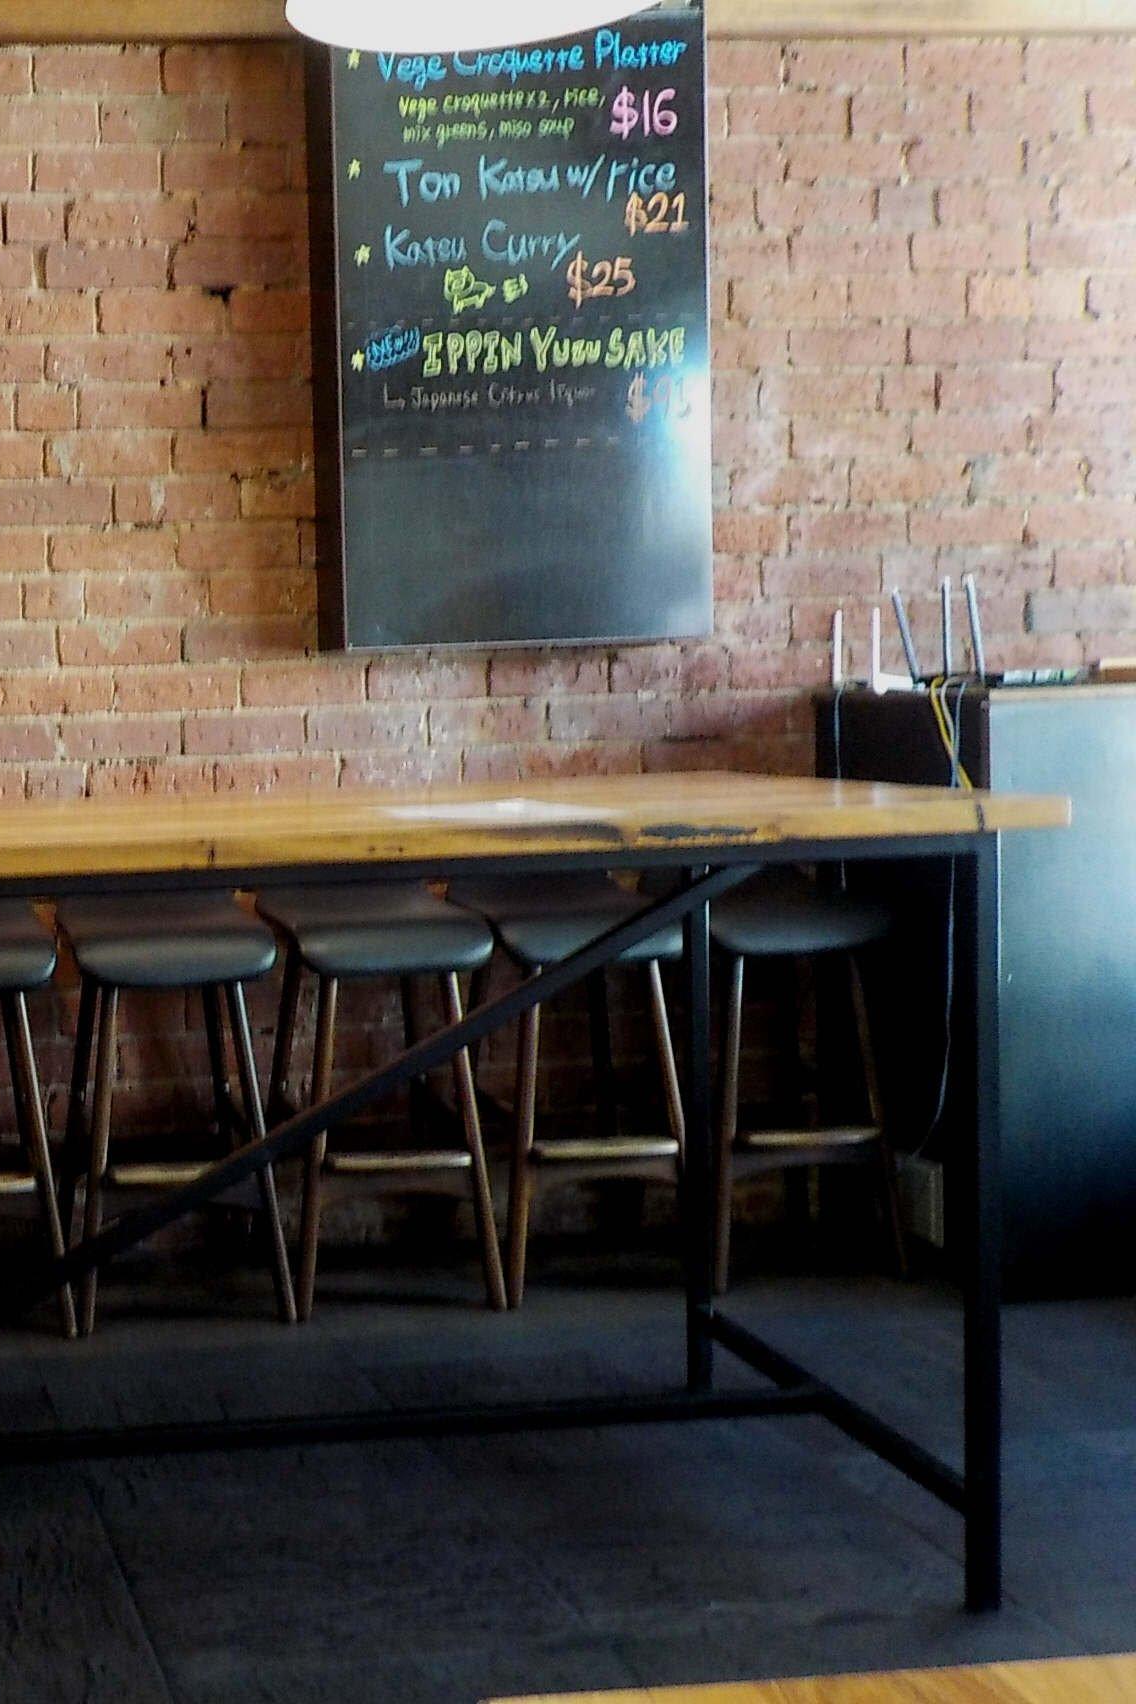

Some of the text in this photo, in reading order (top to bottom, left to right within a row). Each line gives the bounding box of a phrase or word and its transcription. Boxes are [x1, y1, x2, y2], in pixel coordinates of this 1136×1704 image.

[377, 50, 447, 92] Vege
[594, 28, 688, 69] Platter
[609, 86, 678, 140] $16
[383, 158, 461, 208] Ton
[478, 154, 561, 201] Katsu
[624, 191, 689, 237] $21
[384, 219, 582, 271] Katsu Curry
[567, 251, 638, 309] $25
[422, 330, 522, 378] IPPIN
[604, 326, 685, 371] SAKE
[411, 386, 479, 413] Japanese
